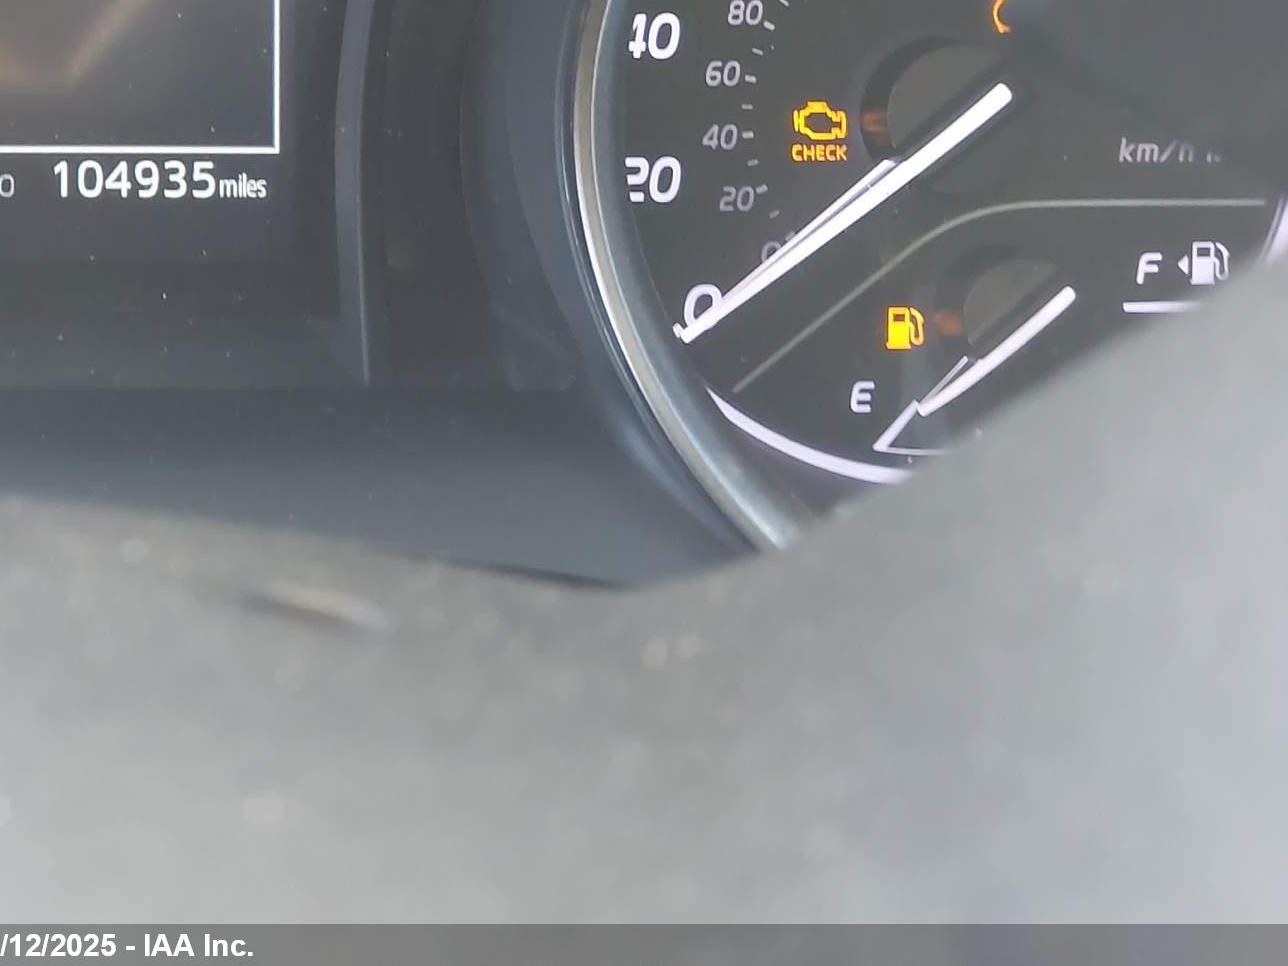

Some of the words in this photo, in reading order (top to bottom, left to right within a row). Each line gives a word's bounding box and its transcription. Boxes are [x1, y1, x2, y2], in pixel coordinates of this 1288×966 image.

[727, 0, 764, 26] 80
[705, 60, 741, 87] 60
[702, 123, 738, 150] 40
[791, 144, 848, 162] CHECK
[53, 159, 217, 199] 104935
[219, 171, 268, 198] miles
[626, 156, 682, 203] 20
[719, 187, 754, 212] 20
[1135, 252, 1163, 285] F
[849, 381, 876, 413] E
